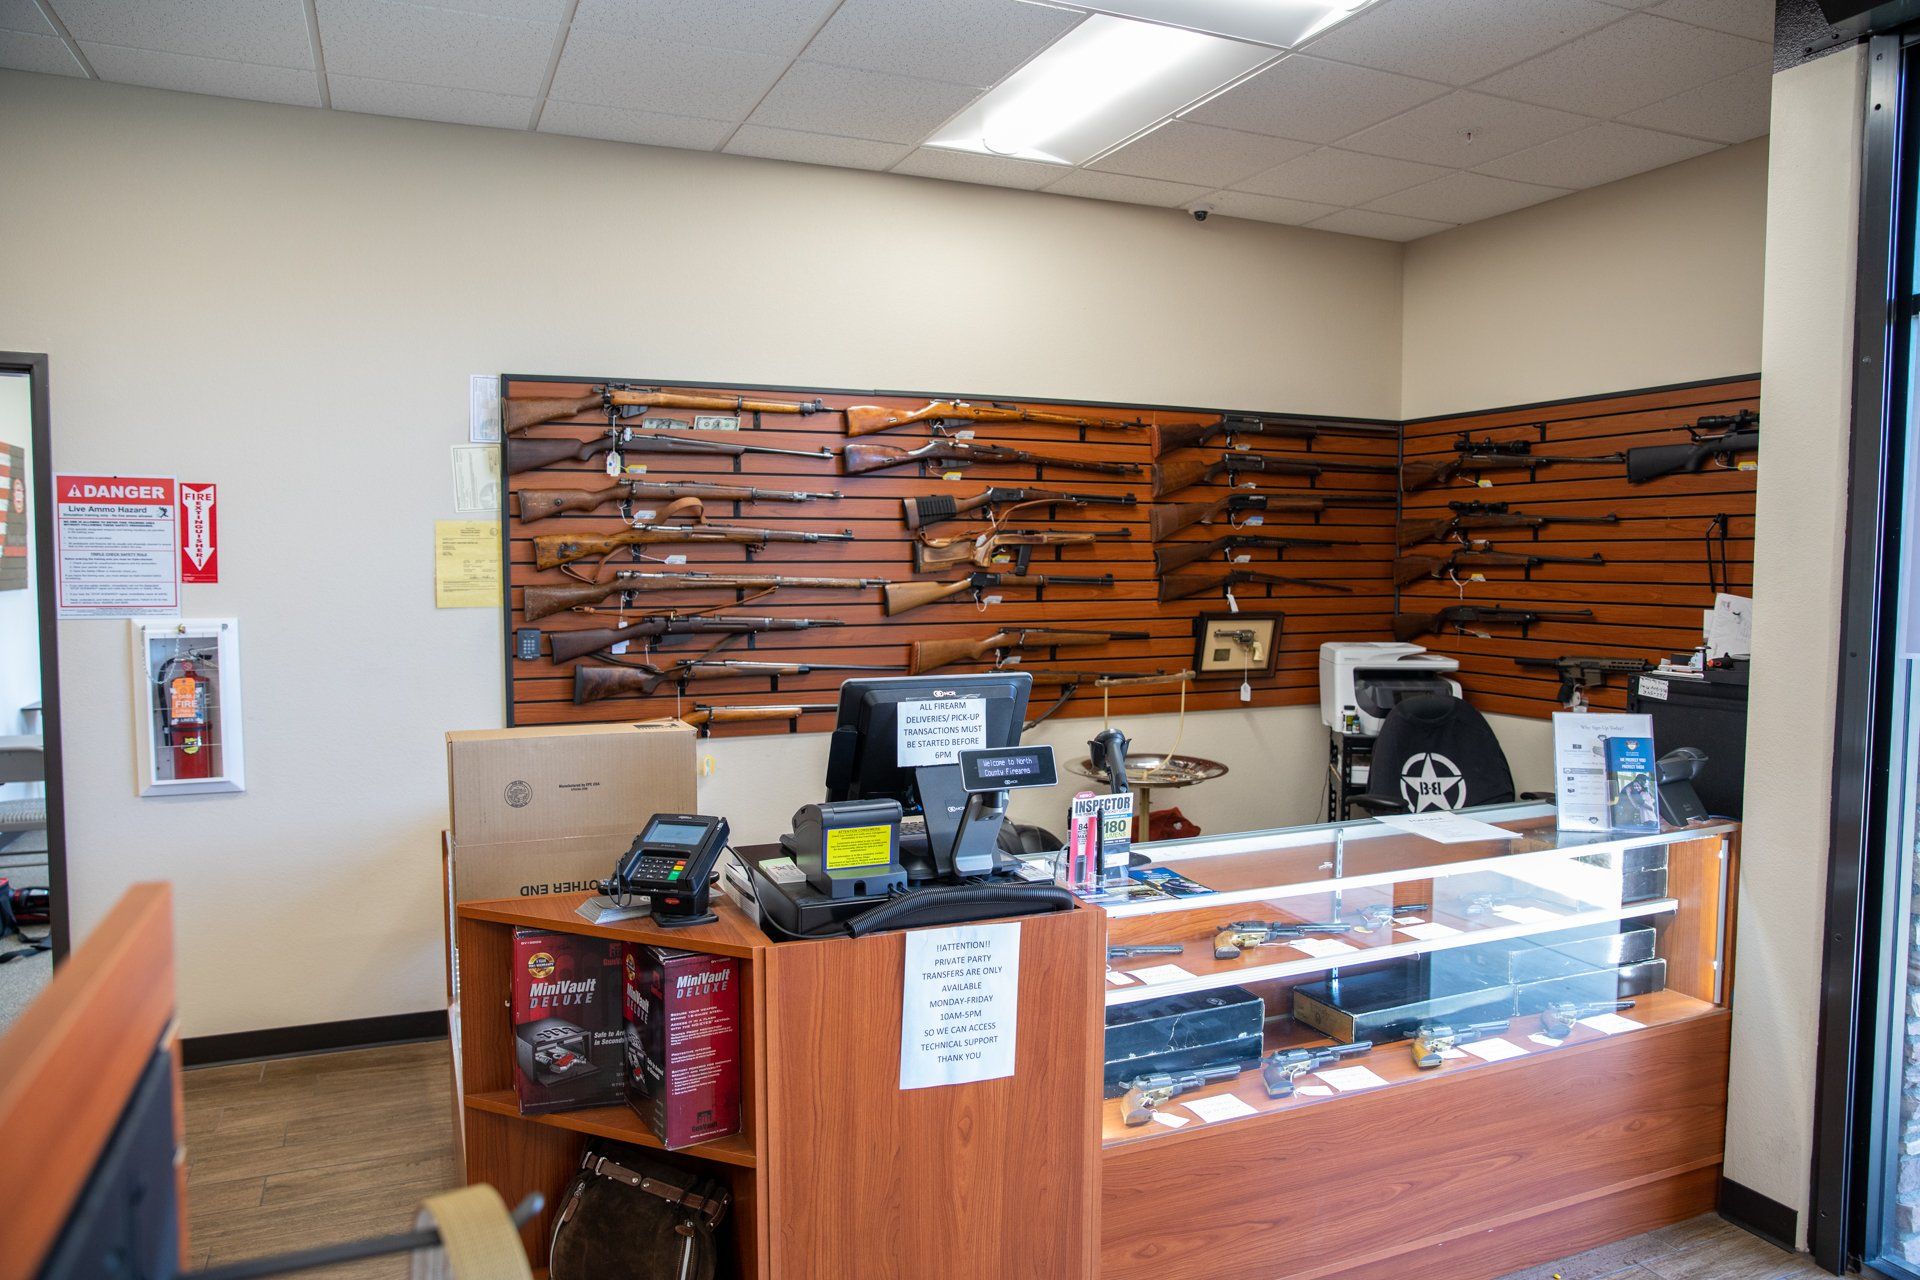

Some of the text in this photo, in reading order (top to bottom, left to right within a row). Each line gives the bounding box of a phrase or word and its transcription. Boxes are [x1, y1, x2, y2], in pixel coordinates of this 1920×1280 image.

[84, 484, 165, 499] DANGER
[194, 501, 203, 558] EXTINGUISHER
[176, 700, 198, 708] FIRE
[934, 702, 967, 710] FIREARM
[906, 713, 980, 724] DELIVERIES/ PICK-UP
[904, 726, 959, 736] TRANSACTIONS
[918, 739, 950, 747] STARTED
[952, 737, 979, 745] BEFORE
[1075, 797, 1130, 813] INSPECTOR
[1104, 820, 1126, 833] 180
[520, 880, 598, 896] OTHER END
[936, 941, 991, 952] !!ATTENTION!!
[934, 955, 992, 966] PRIVATE PARTY
[676, 969, 730, 988] MiniVault
[922, 966, 1002, 980] TRANSFERS ARE ONLY
[530, 979, 596, 997] MiniVault
[677, 982, 728, 998] DELUXE
[942, 982, 982, 992] AVAILABLE
[530, 993, 593, 1009] DELUXE
[930, 995, 994, 1008] MONDAY-FRIDAY
[940, 1010, 982, 1020] 10AM-5PM
[924, 1022, 996, 1036] SO WE CAN ACCESS
[921, 1036, 998, 1050] TECHNICAL SUPPORT
[938, 1054, 963, 1063] THANK
